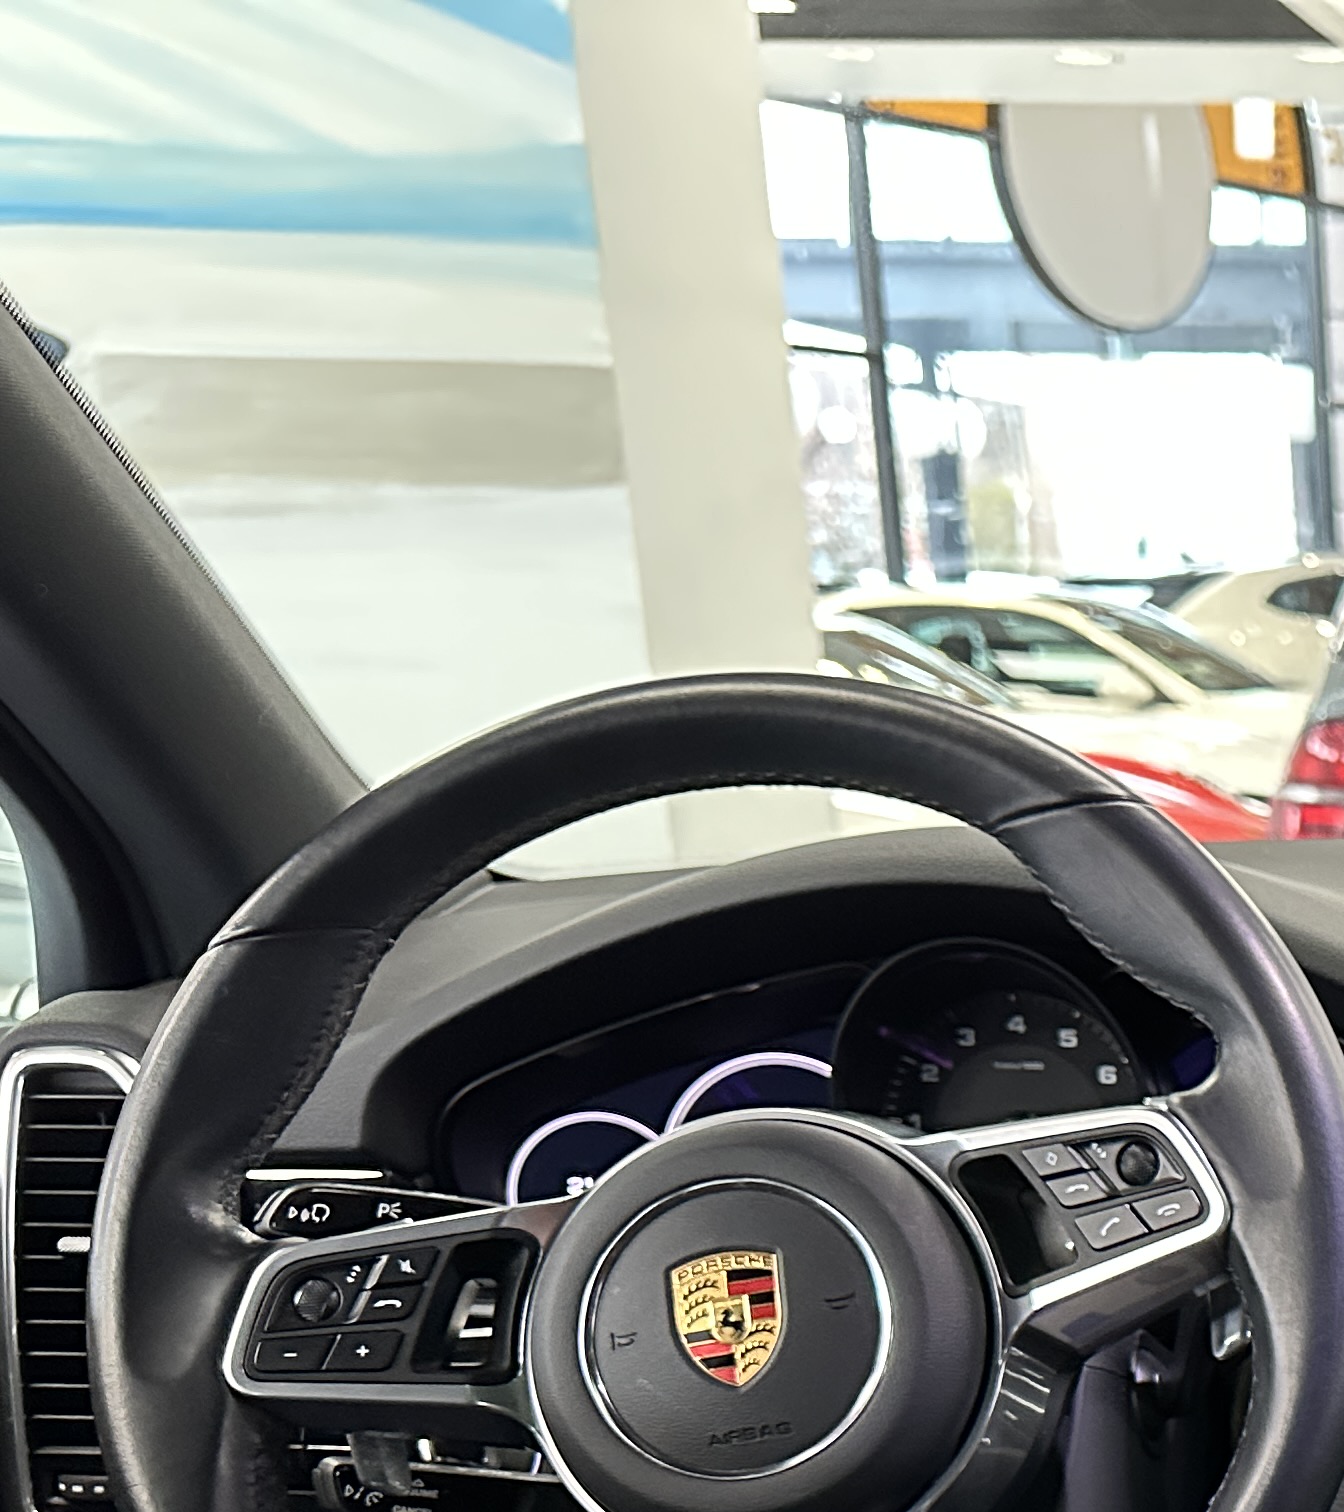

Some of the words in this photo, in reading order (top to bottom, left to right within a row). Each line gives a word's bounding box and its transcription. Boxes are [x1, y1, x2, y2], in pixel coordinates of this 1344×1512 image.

[1007, 1014, 1027, 1034] 4
[956, 1028, 976, 1047] 3
[1058, 1028, 1079, 1048] 5
[920, 1063, 940, 1083] 2
[1097, 1065, 1118, 1085] 6
[678, 1254, 775, 1281] PORSCHE
